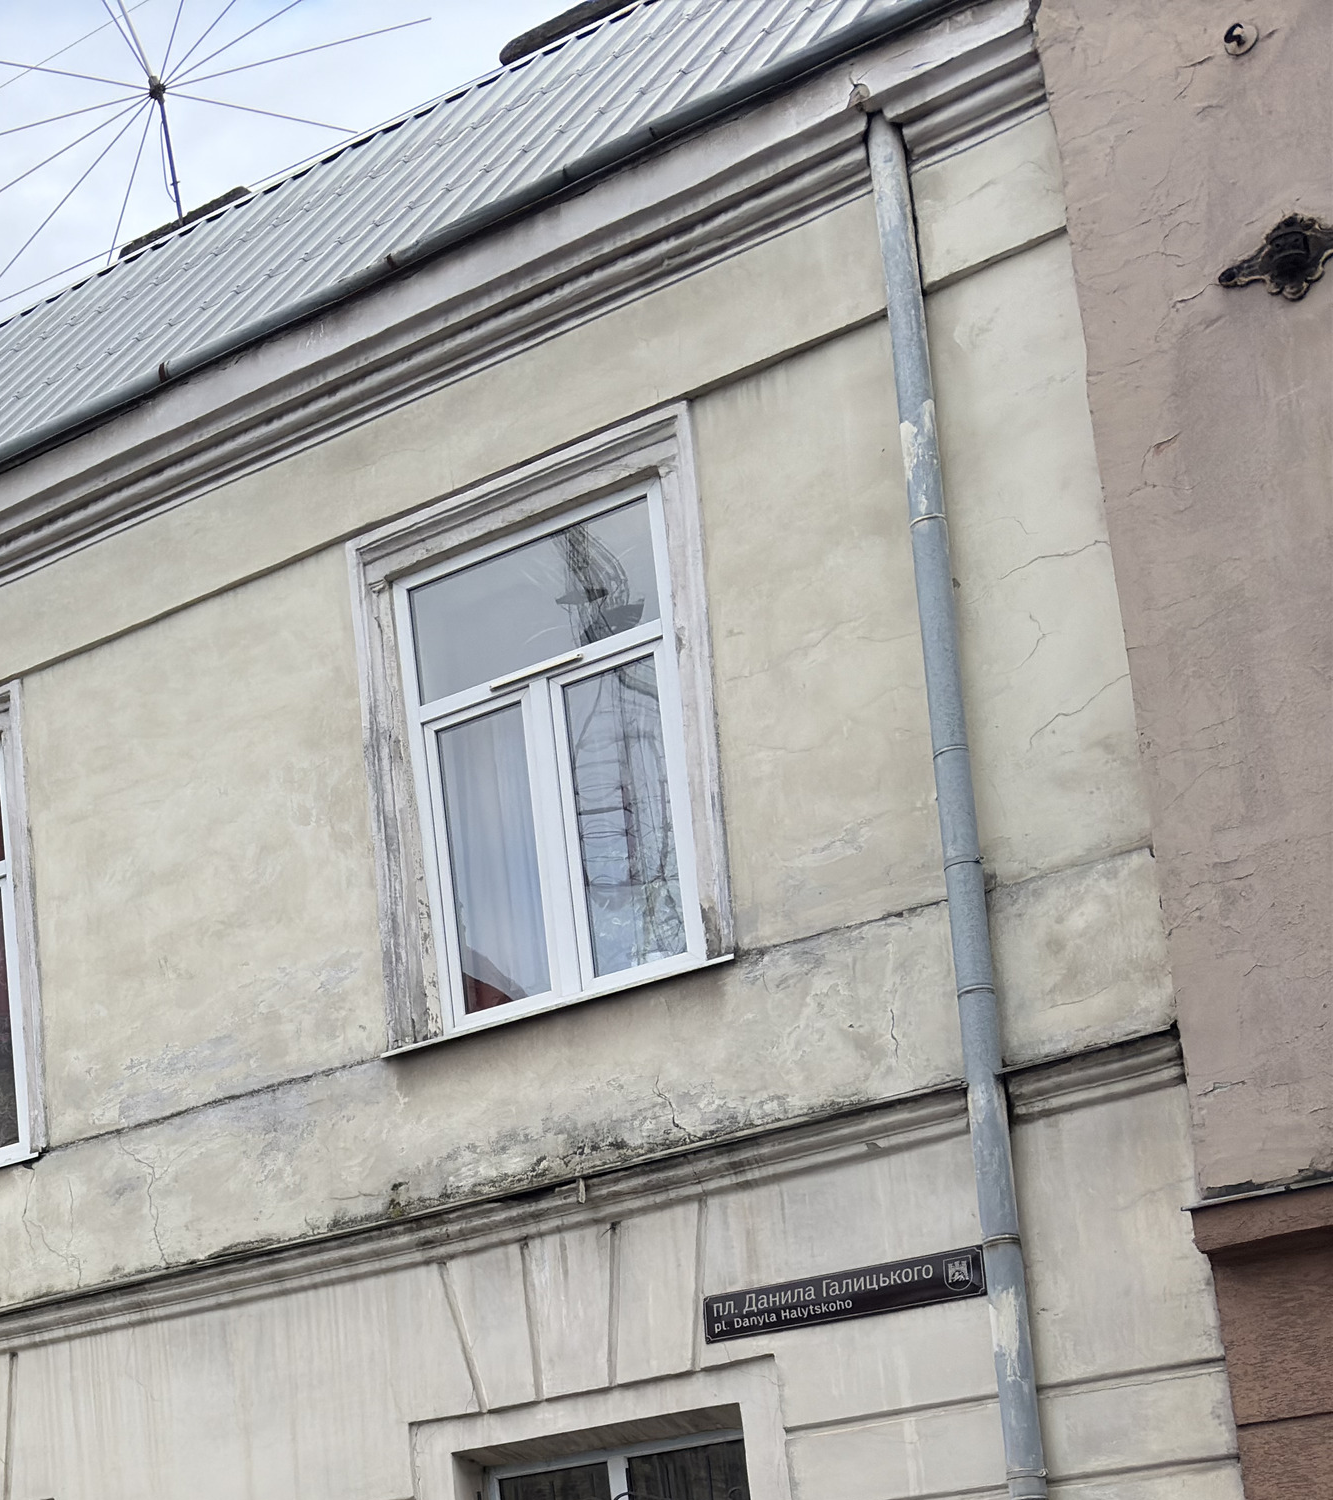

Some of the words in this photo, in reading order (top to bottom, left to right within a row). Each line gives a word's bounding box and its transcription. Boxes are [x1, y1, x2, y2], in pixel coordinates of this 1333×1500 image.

[713, 1301, 738, 1317] пл.
[743, 1286, 815, 1314] Данила
[822, 1264, 934, 1297] Галицького
[714, 1321, 730, 1334] pl.
[734, 1312, 777, 1329] Danyla
[781, 1299, 853, 1321] Halytskoho
